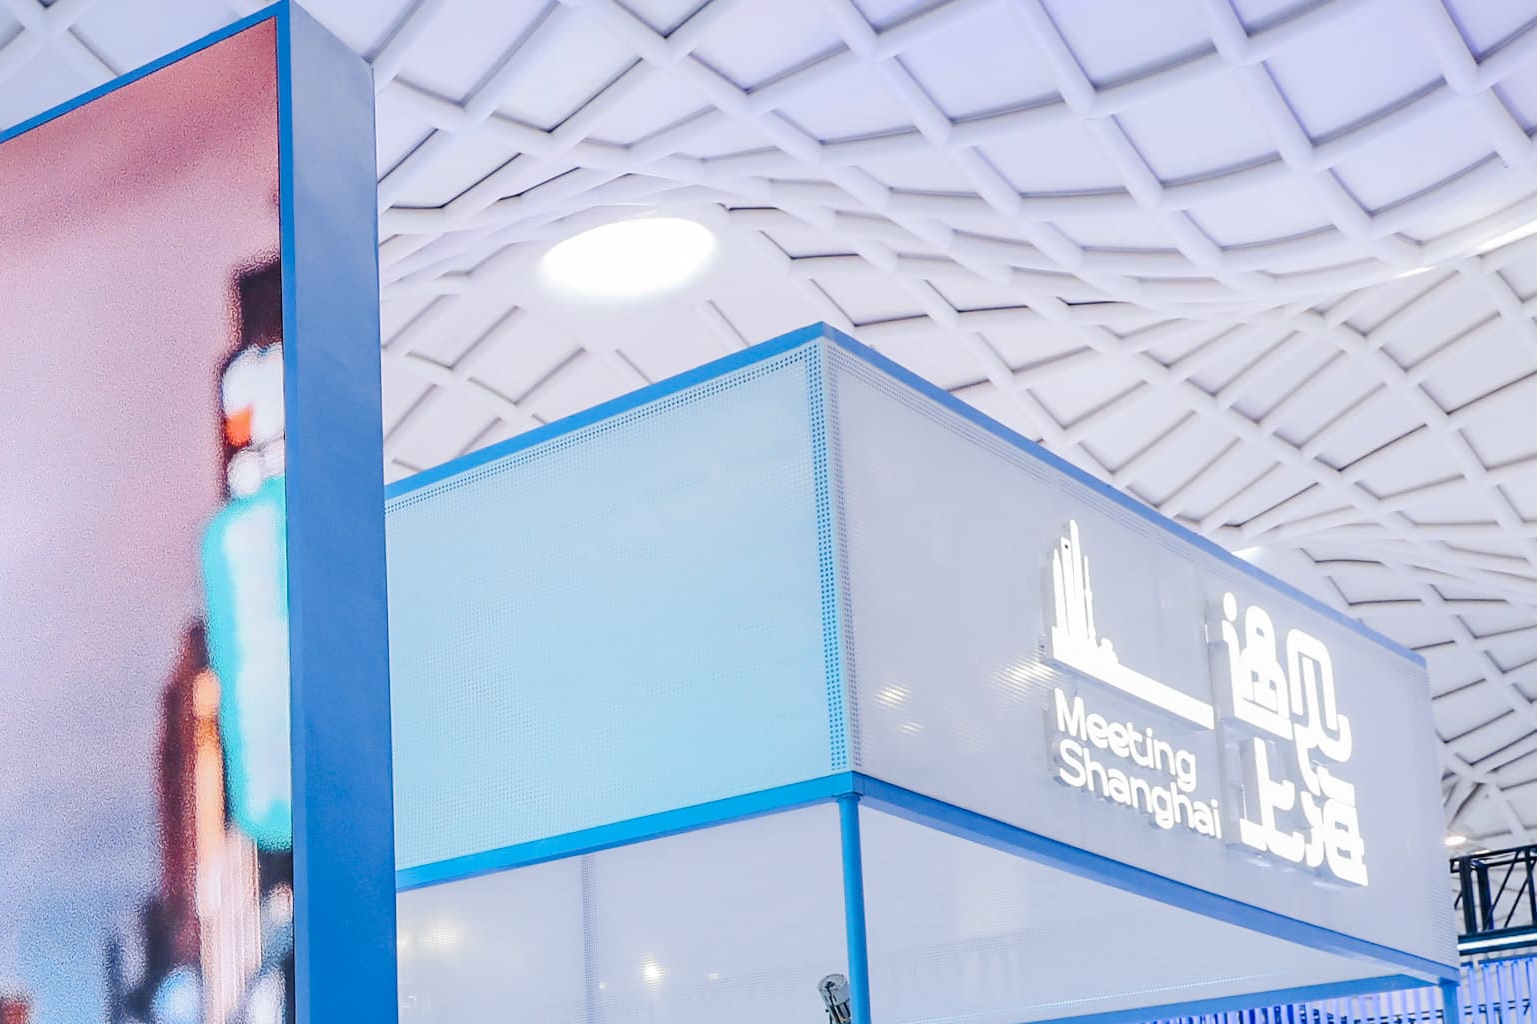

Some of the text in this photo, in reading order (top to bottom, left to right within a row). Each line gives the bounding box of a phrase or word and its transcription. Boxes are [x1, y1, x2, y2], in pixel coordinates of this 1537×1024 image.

[1054, 688, 1197, 791] Meeting
[1221, 592, 1352, 775] 遇见
[1058, 738, 1223, 839] Shanghai
[1239, 739, 1369, 887] 上海
